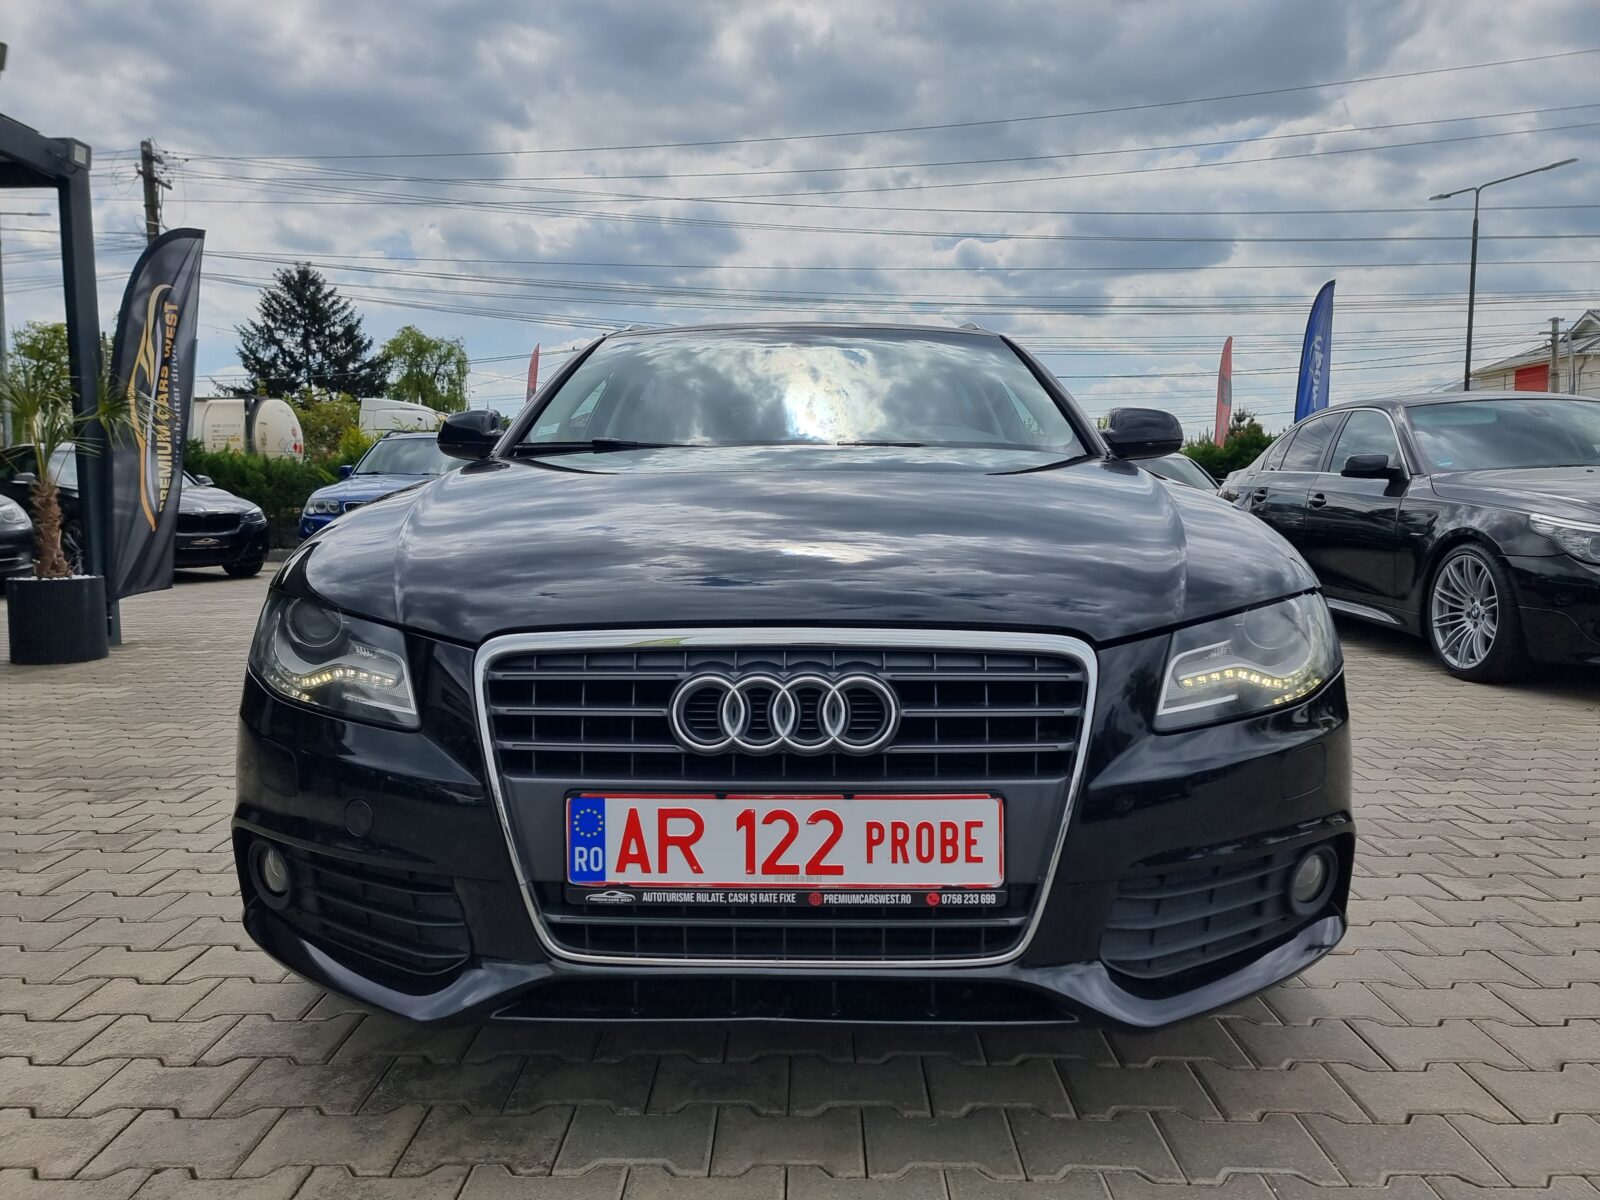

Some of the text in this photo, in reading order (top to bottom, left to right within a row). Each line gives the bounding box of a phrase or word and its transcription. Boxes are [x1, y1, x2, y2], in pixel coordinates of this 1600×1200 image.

[163, 301, 179, 358] WEST
[156, 365, 171, 419] CARS
[615, 808, 984, 876] AR 122 PROBE
[574, 846, 602, 872] RO
[642, 892, 695, 903] AUTOTURISME
[697, 893, 727, 904] RULATE,
[728, 893, 748, 904] CASH
[759, 893, 778, 904] RATE
[779, 893, 796, 904] FIXE
[823, 893, 911, 904] PREMIUMCARSWEST.RO
[941, 893, 997, 905] 0758 233 699
